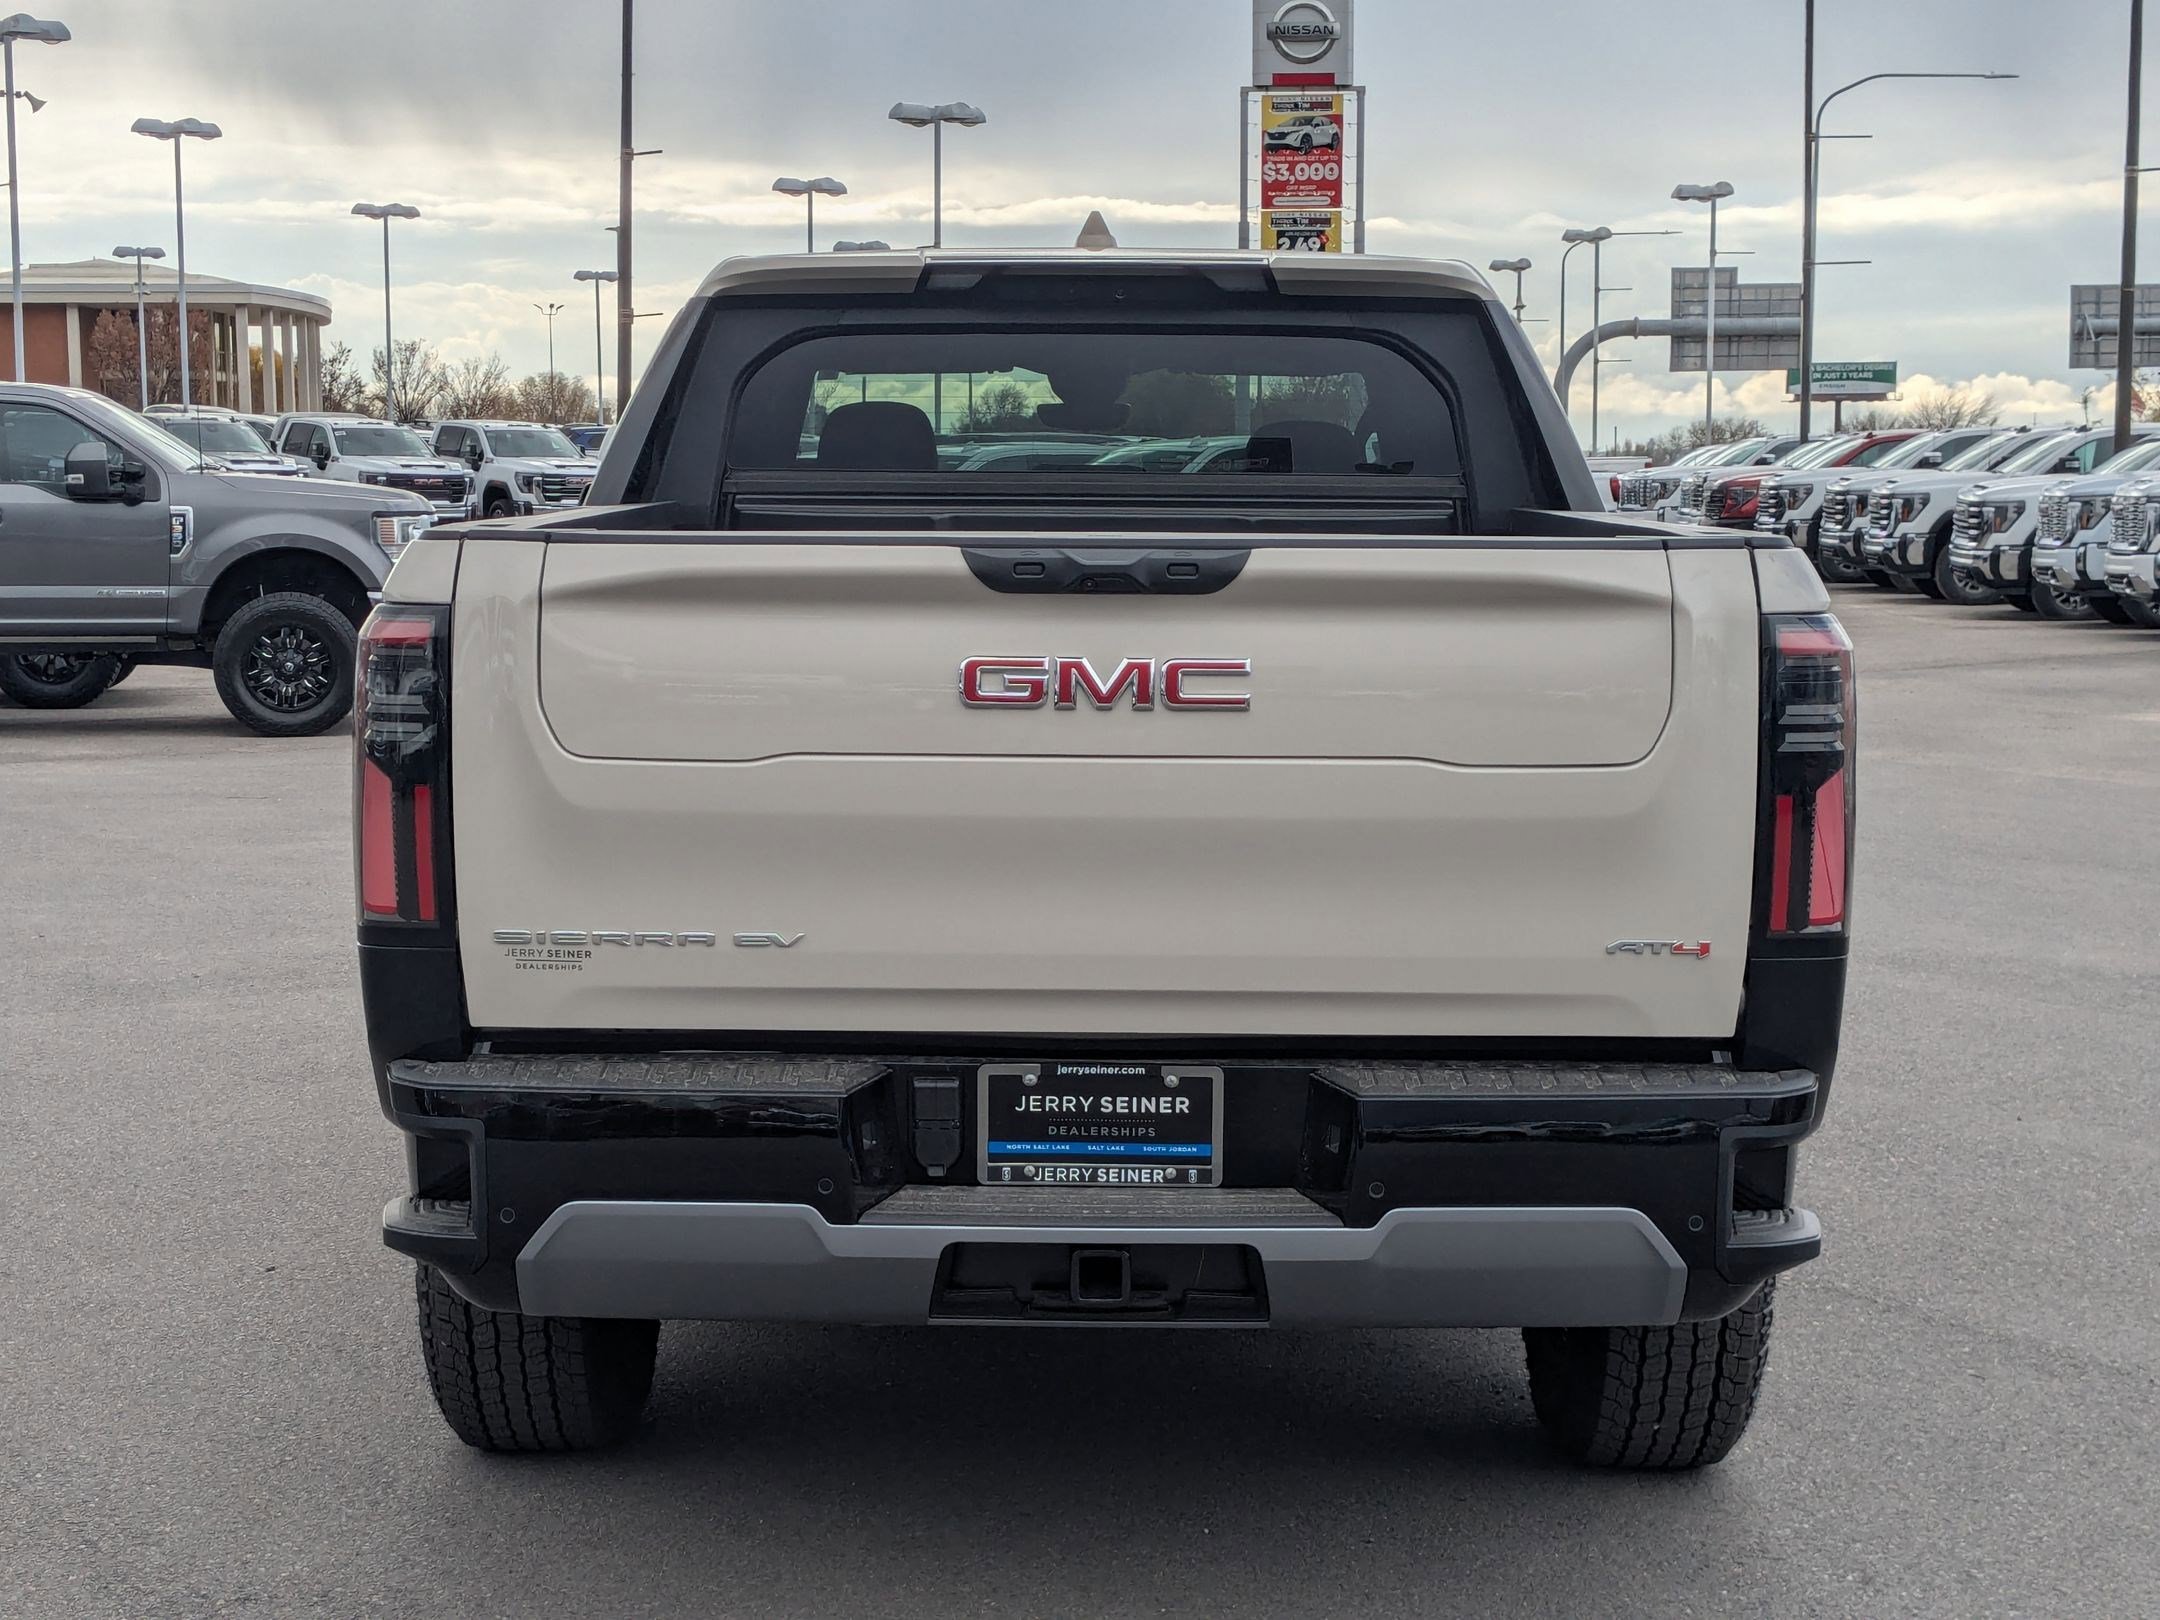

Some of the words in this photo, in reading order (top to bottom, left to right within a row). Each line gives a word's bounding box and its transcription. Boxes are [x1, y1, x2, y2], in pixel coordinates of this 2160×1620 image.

[1275, 25, 1335, 35] NISSAN
[1263, 161, 1339, 184] $3,000
[959, 655, 1251, 712] GMC
[493, 929, 716, 947] SIERRA
[733, 931, 805, 947] EV
[504, 948, 544, 957] JERRY
[547, 949, 592, 958] SEINER
[1606, 939, 1712, 960] AT4
[515, 963, 583, 971] DEALERSHIPS
[1057, 1064, 1146, 1075] jerryseiner.com
[1015, 1095, 1094, 1112] JERRY
[1100, 1097, 1190, 1114] SEINER
[1048, 1125, 1156, 1137] DEALERSHIPS
[1033, 1167, 1093, 1183] JERRY
[1097, 1168, 1165, 1183] SEINER
